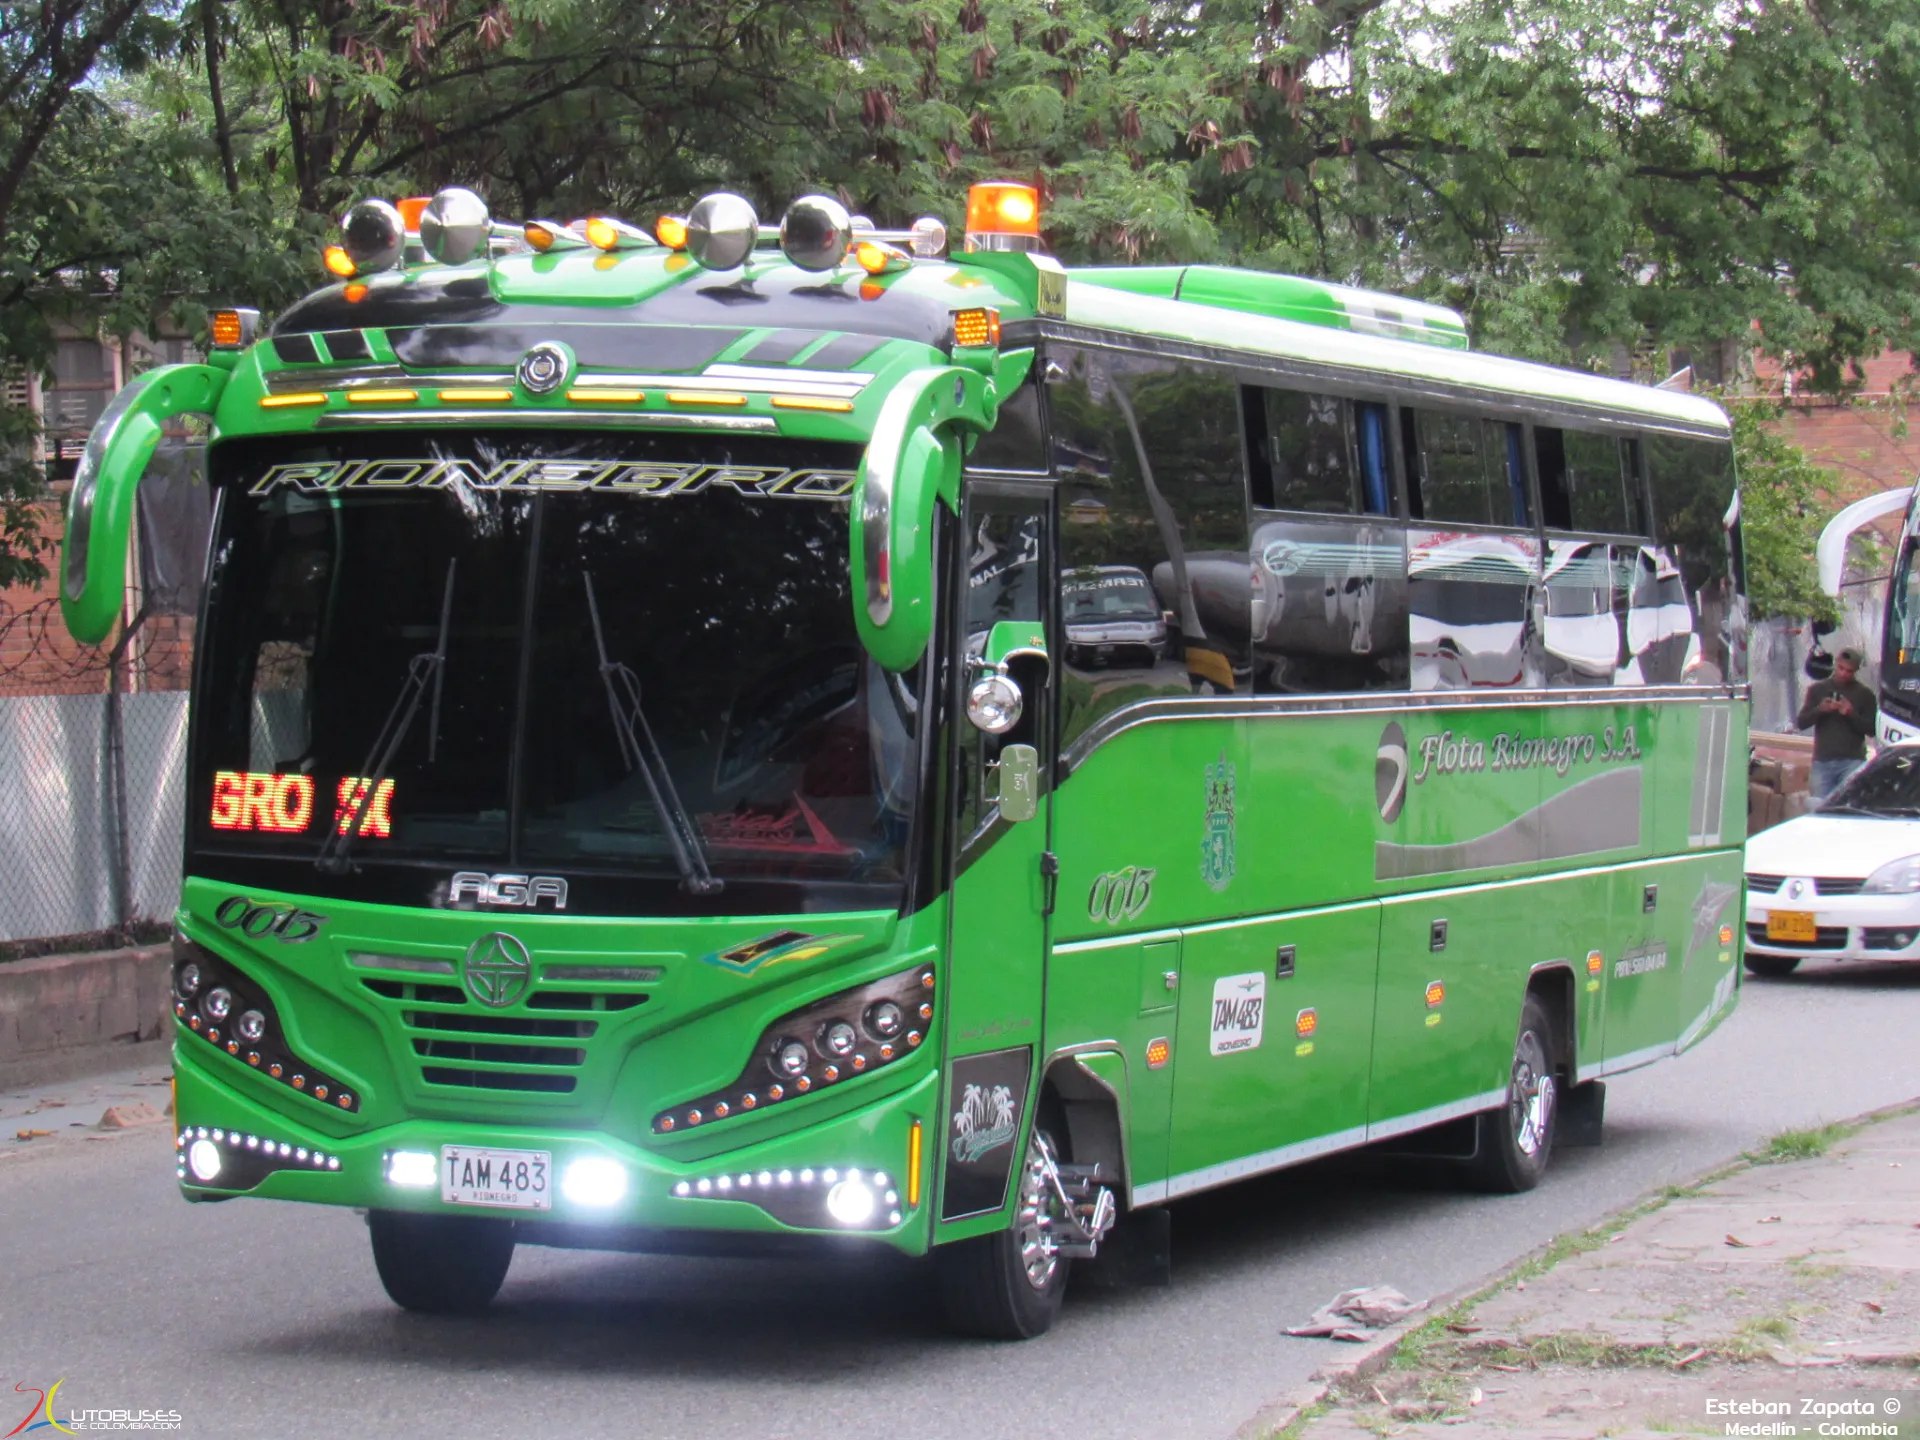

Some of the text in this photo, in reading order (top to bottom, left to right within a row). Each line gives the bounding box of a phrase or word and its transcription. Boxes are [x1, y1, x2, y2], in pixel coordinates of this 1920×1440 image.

[248, 458, 858, 500] RIONEGRO
[1414, 725, 1642, 783] Flota Rionegro S.A.
[211, 771, 314, 833] GRO
[449, 871, 569, 909] AGA
[1213, 996, 1262, 1032] TAM 483
[446, 1156, 546, 1192] TAM 483
[473, 1191, 517, 1203] RIONEGRO
